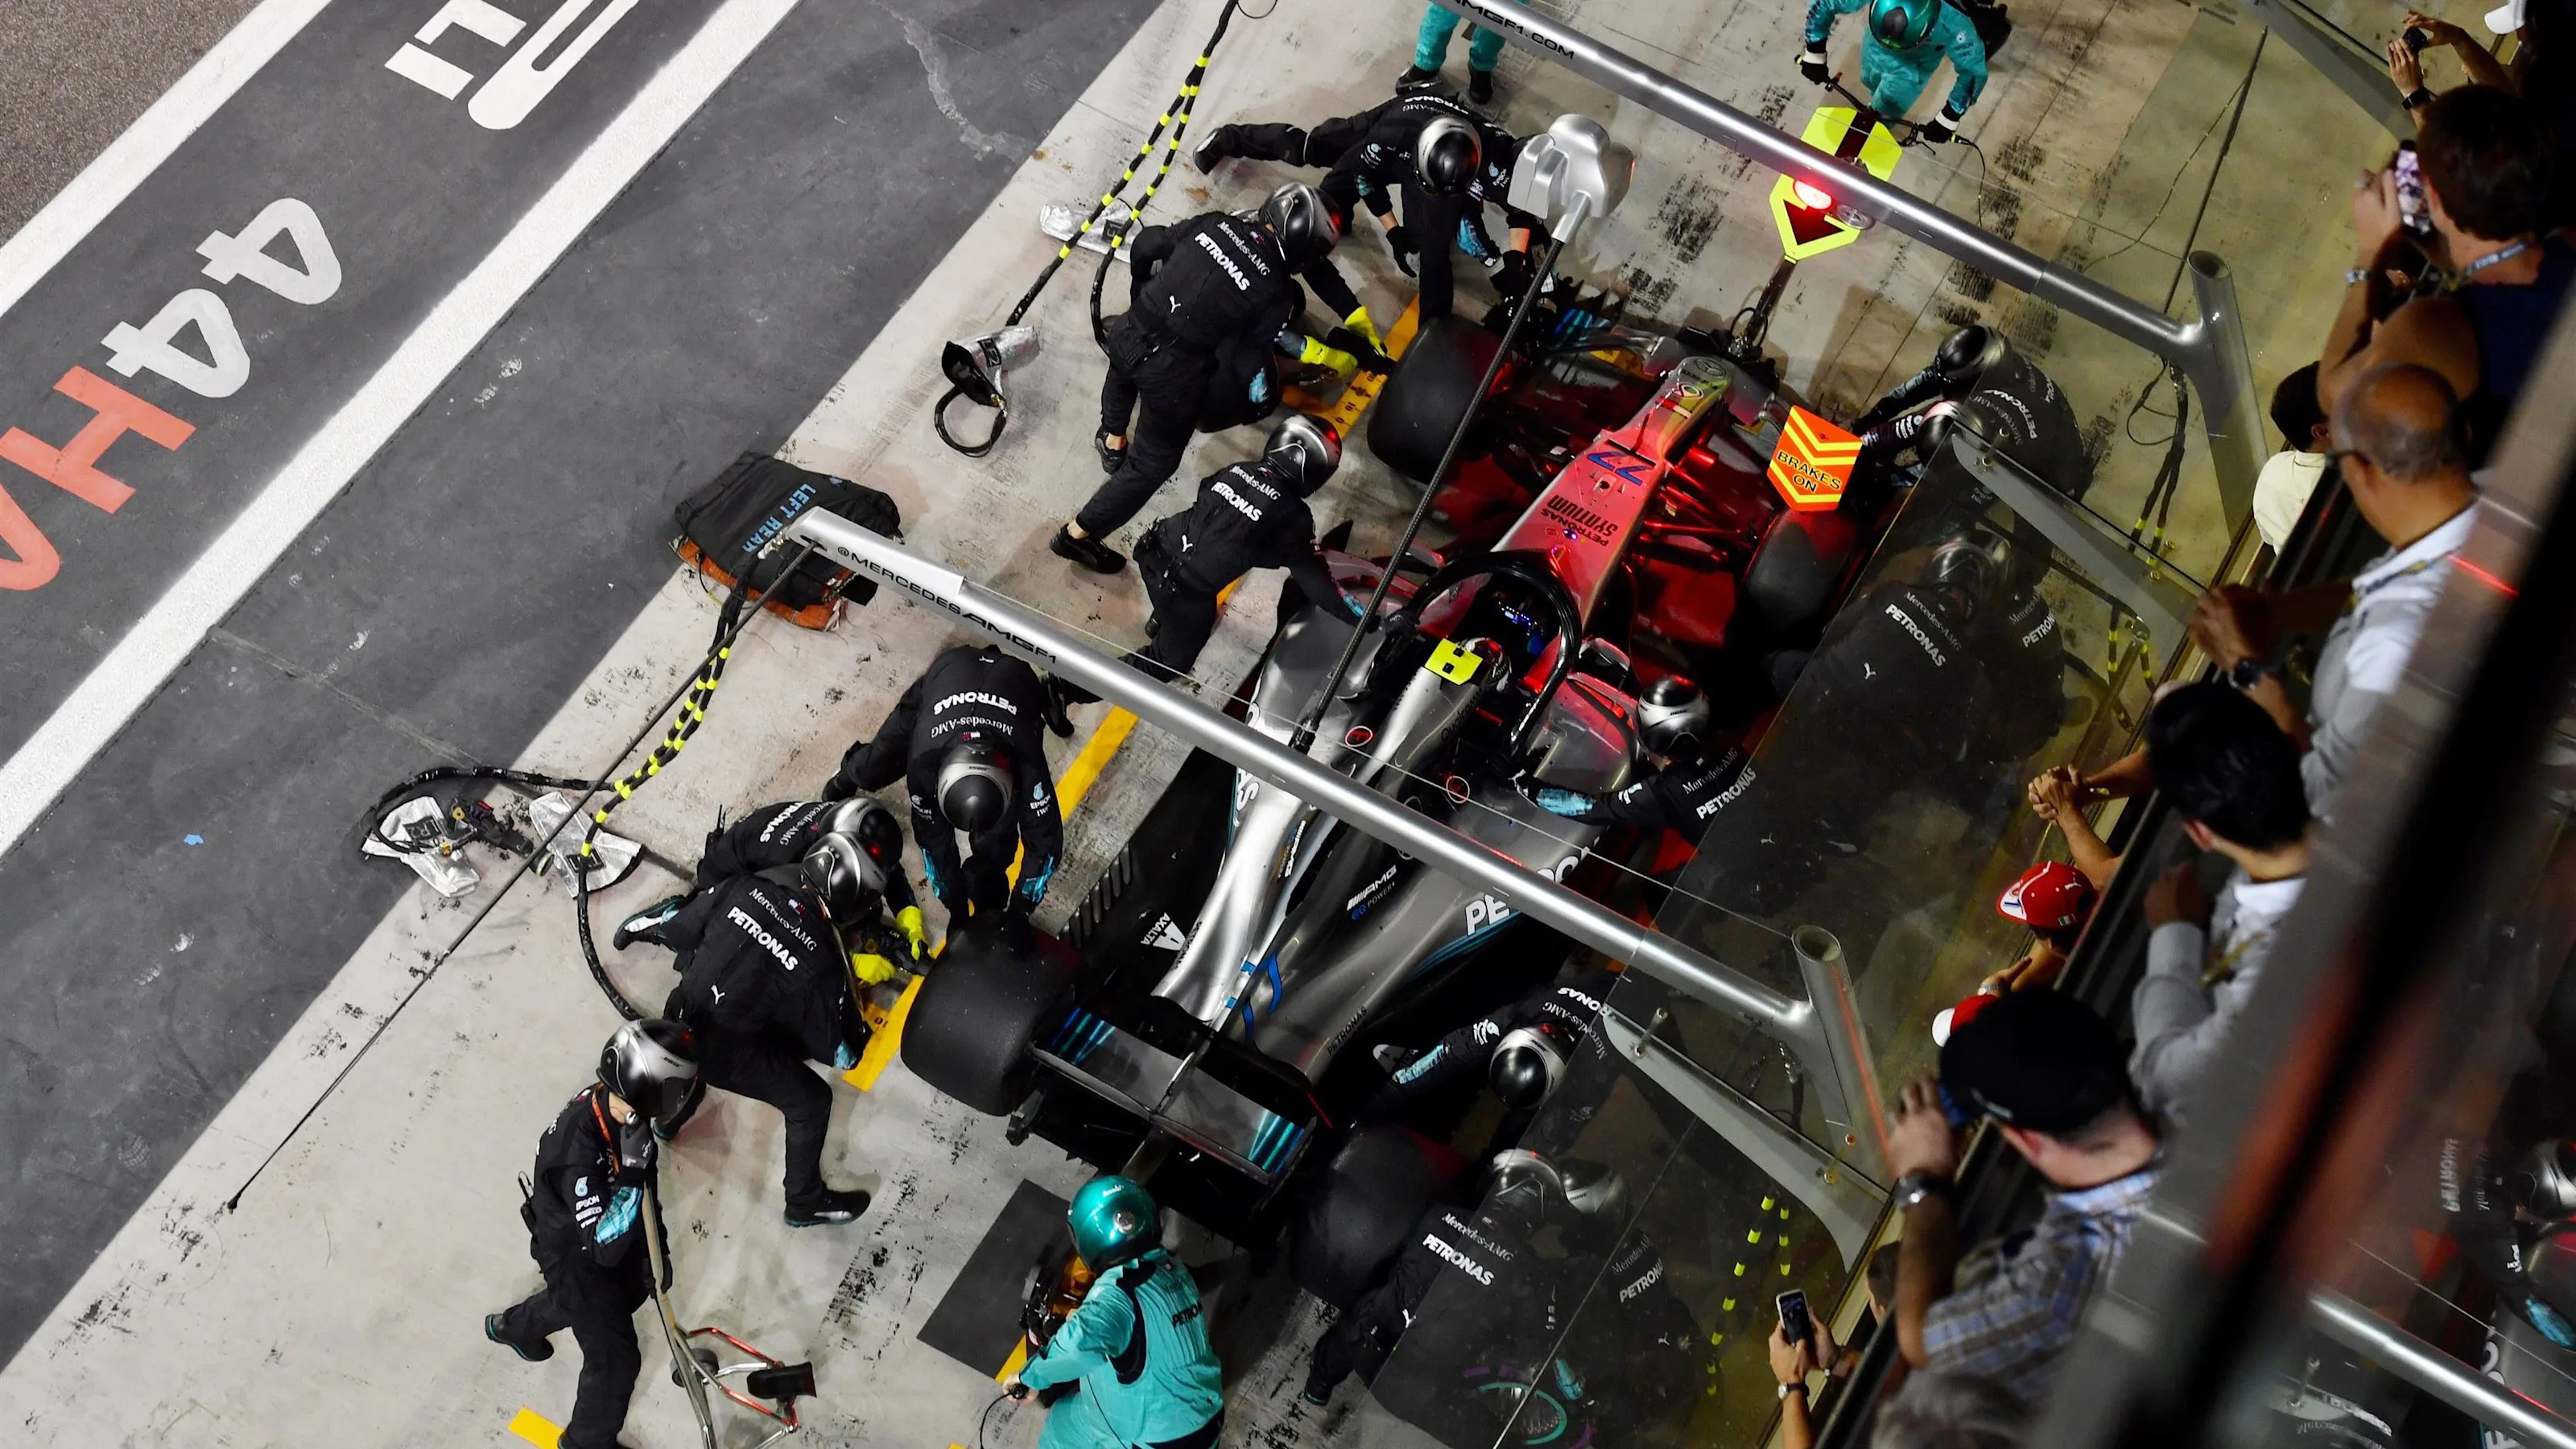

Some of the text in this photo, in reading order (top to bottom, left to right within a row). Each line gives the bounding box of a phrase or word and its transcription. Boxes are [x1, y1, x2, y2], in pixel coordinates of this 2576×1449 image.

[1195, 232, 1250, 291] PETRONAS
[1217, 221, 1270, 276] Mercedes-AMG
[1586, 451, 1657, 486] 77
[1777, 451, 1841, 490] BRAKES
[1794, 475, 1816, 492] ON
[742, 483, 816, 552] LEFT REAR
[1211, 481, 1262, 522] PETRONAS
[1546, 494, 1619, 539] SYNTIUM
[1541, 508, 1609, 547] PETRONAS
[1885, 604, 1946, 667] PETRONAS
[931, 716, 1013, 738] Mercedes-AMG
[934, 691, 1018, 715] PETRONAS
[1682, 747, 1738, 795] Mercedes-AMG
[1696, 767, 1757, 819] PETRONAS
[727, 906, 799, 971] PETRONAS
[749, 888, 818, 952] Mercedes-AMG
[1140, 912, 1170, 945] AXALTA
[1328, 1005, 1368, 1056] PETRONAS
[1422, 1233, 1495, 1286] PETRONAS
[1442, 1212, 1515, 1261] Mercedes-AMG
